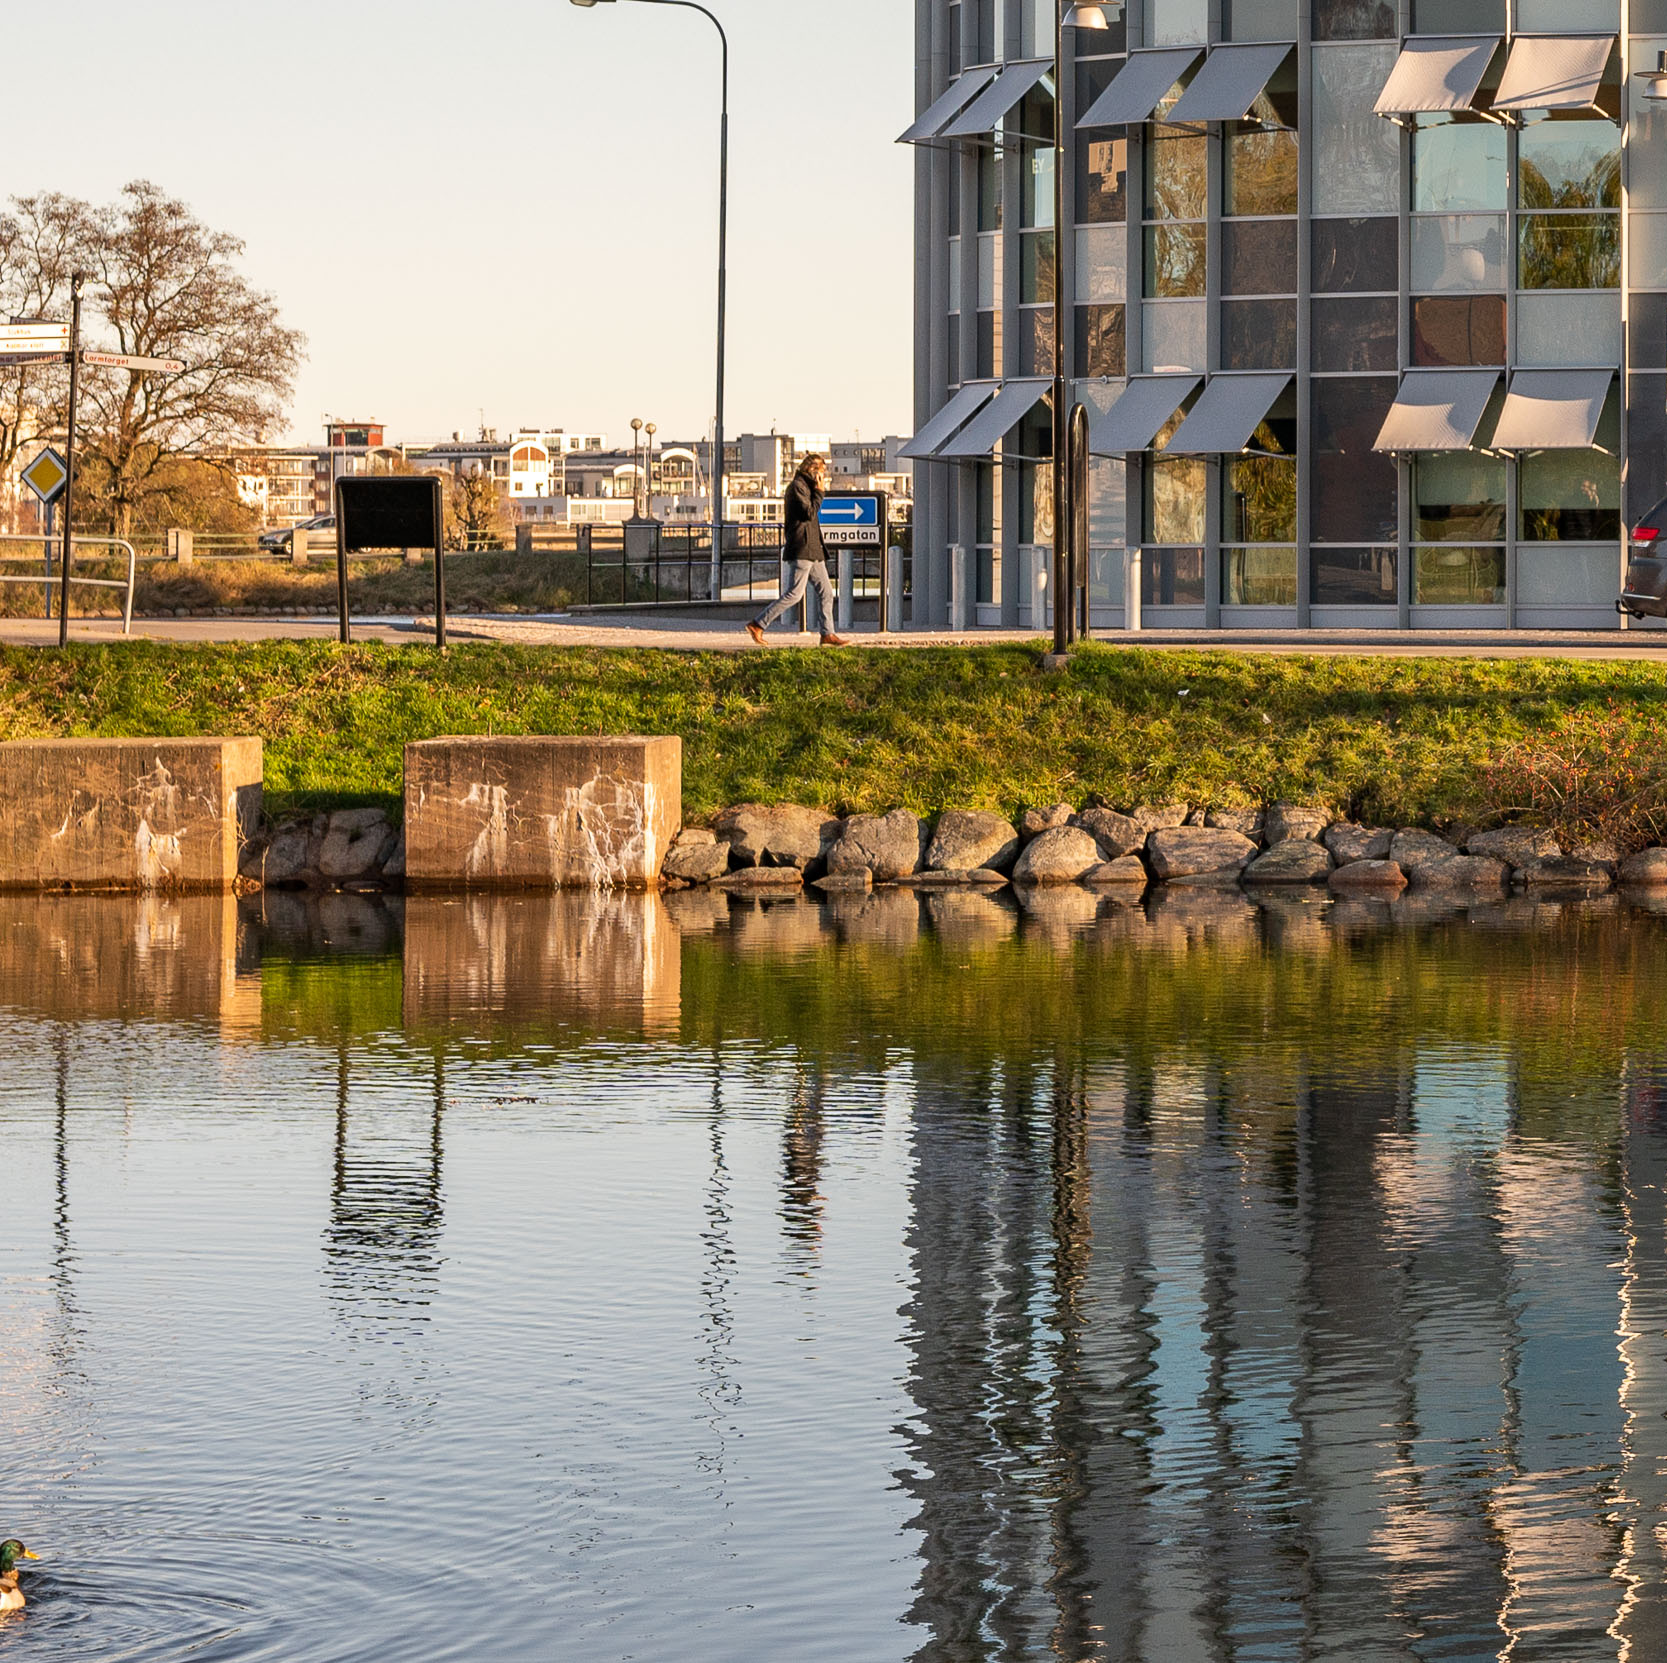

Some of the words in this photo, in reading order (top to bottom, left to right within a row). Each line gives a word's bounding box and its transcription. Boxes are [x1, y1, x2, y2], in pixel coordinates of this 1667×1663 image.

[84, 353, 129, 366] Larmtorget
[164, 362, 179, 371] 0,4
[823, 529, 876, 542] rmgatan
